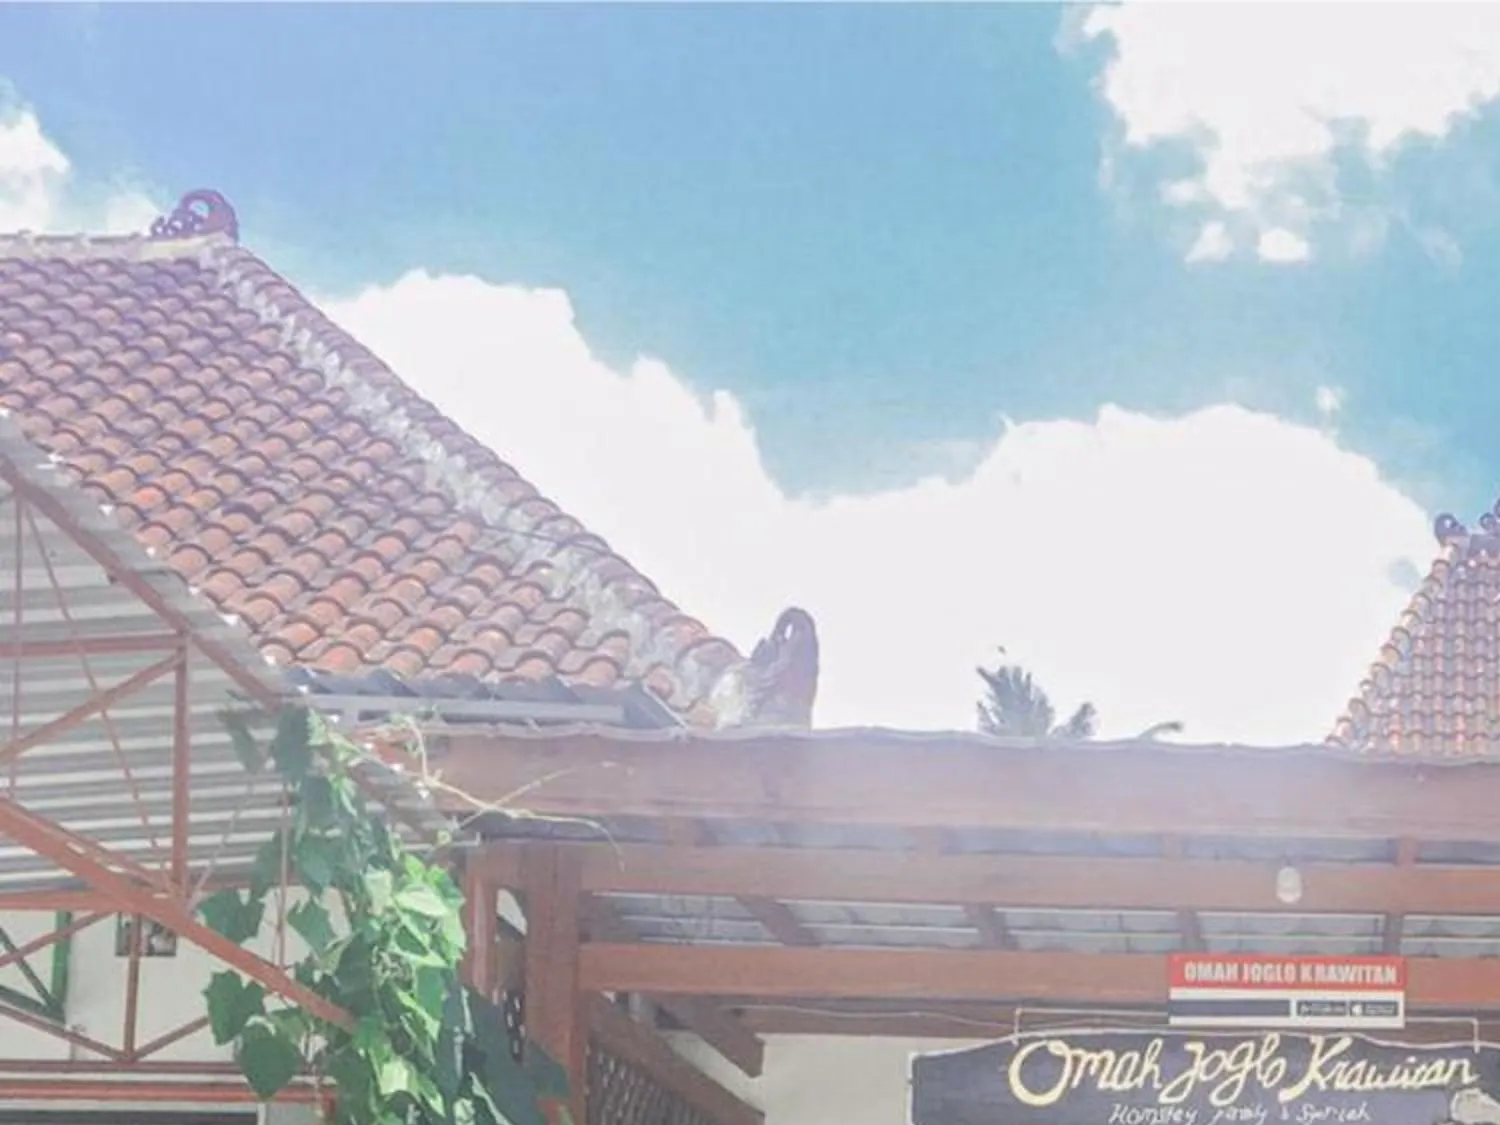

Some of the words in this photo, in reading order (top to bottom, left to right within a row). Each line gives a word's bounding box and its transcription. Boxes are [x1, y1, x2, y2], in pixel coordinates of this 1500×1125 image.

[1184, 962, 1239, 982] OMAH
[1243, 963, 1297, 983] JOGLO
[1301, 964, 1396, 983] KRAWITAN
[1008, 1038, 1163, 1106] Omah
